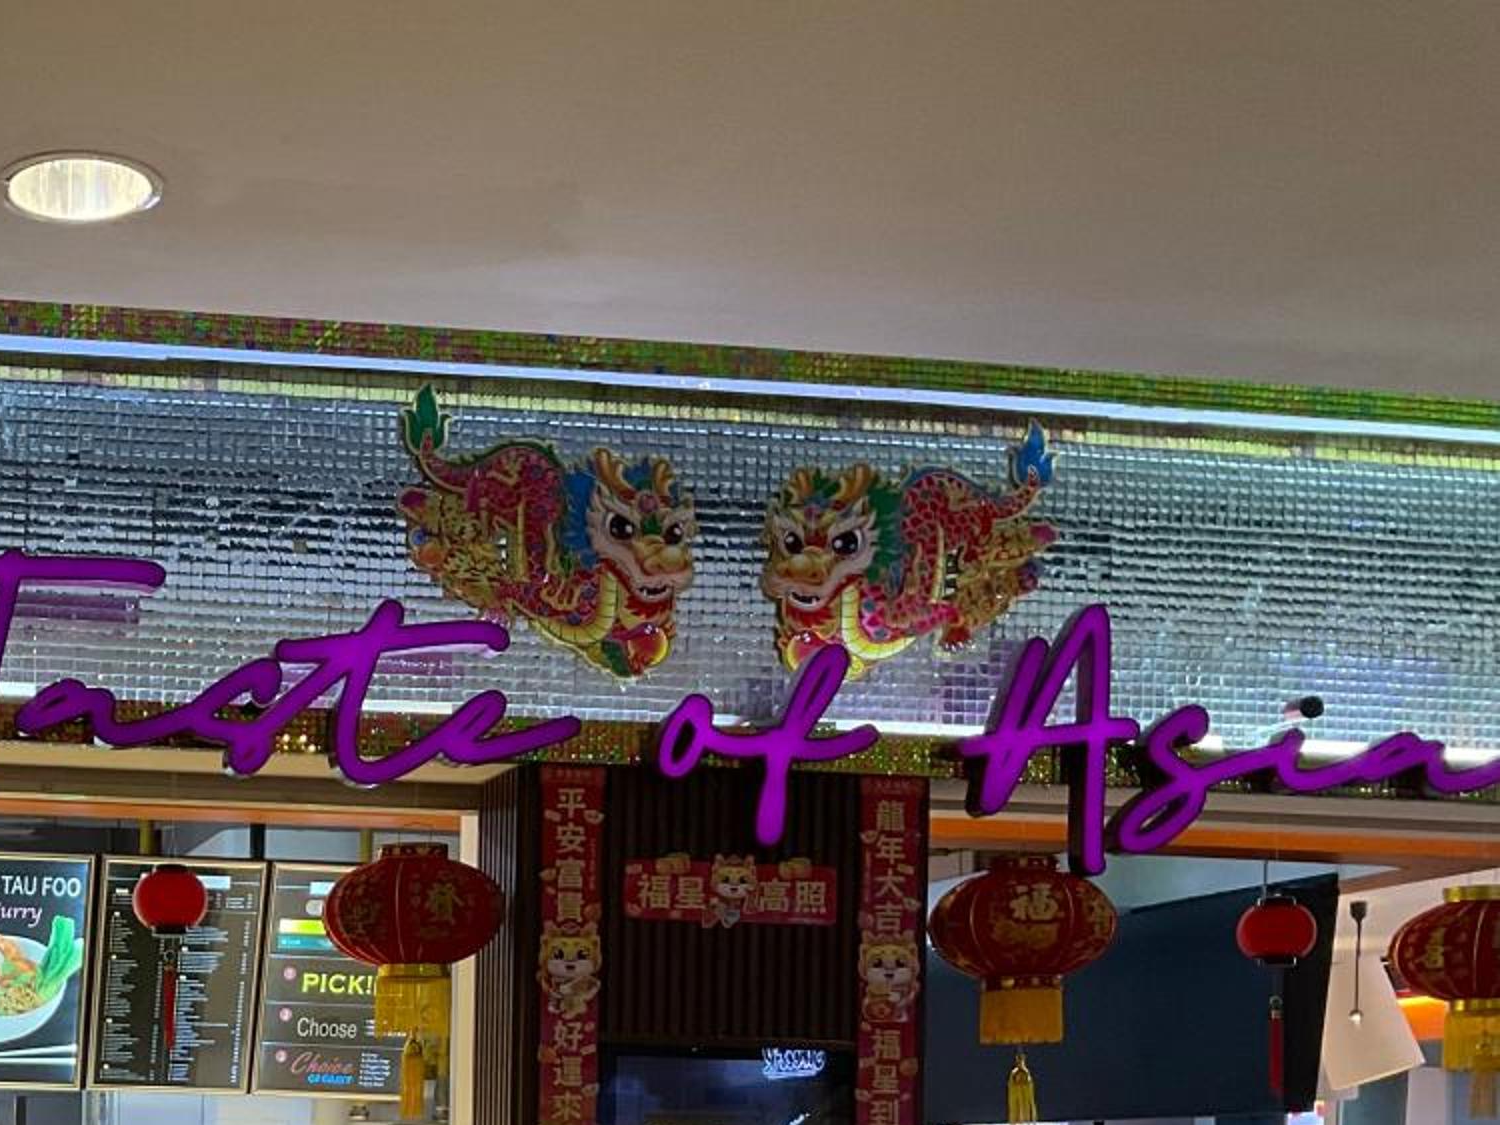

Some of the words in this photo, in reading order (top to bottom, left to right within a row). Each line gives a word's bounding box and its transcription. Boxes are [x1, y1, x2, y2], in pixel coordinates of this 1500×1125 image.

[657, 642, 882, 847] of
[957, 602, 1500, 876] Asia
[3, 875, 37, 896] TAU
[41, 876, 82, 897] FOO
[874, 799, 906, 936] 龍年大吉
[637, 874, 706, 910] 福星
[759, 878, 828, 914] 高照
[296, 1016, 358, 1039] Choose
